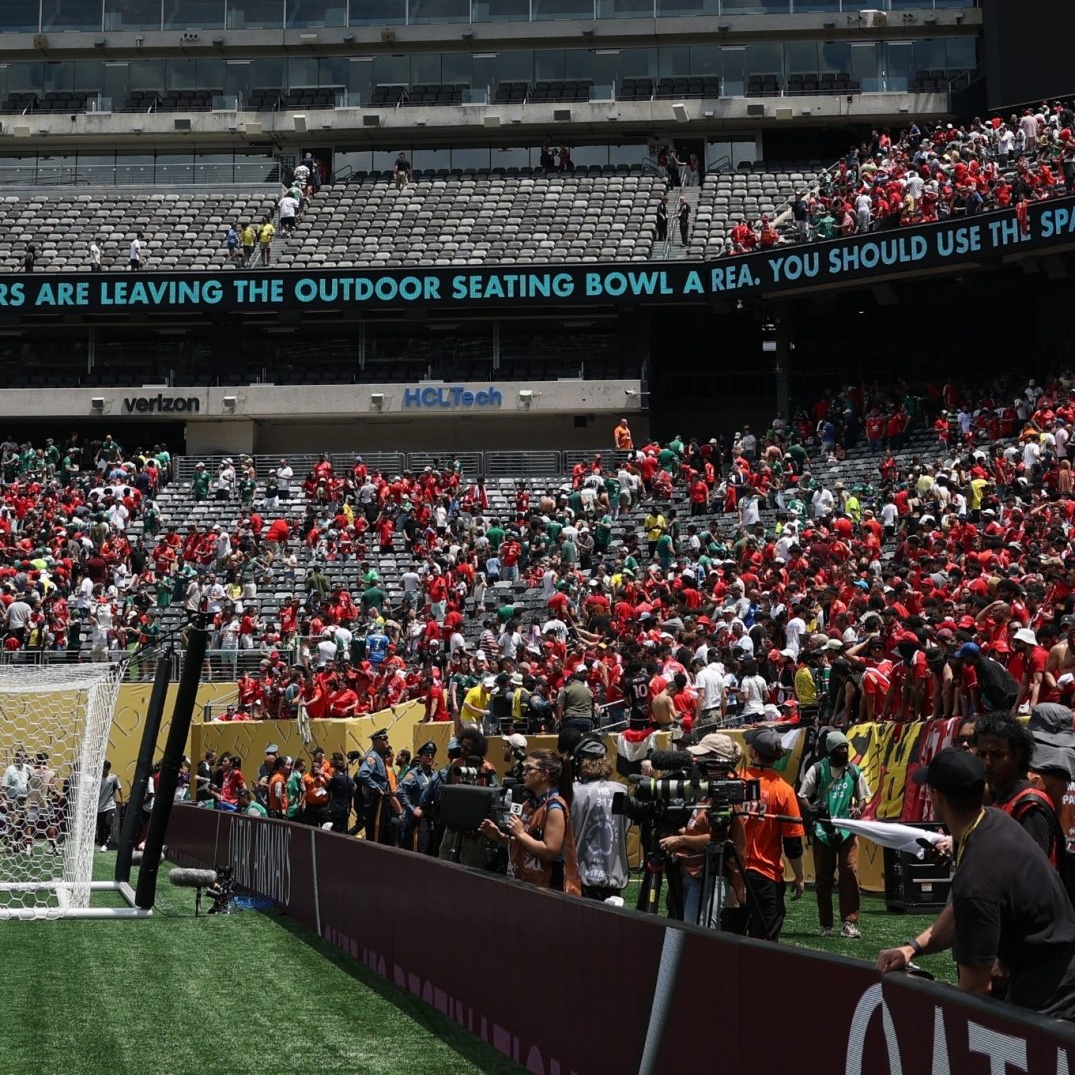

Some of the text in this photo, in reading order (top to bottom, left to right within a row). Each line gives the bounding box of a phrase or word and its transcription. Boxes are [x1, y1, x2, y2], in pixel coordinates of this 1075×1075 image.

[35, 282, 89, 305] ARE
[100, 279, 224, 305] LEAVING
[233, 279, 284, 303] THE
[295, 275, 442, 302] OUTDOOR
[451, 272, 575, 300] SEATING
[586, 271, 674, 297] BOWL
[768, 252, 820, 282] YOU
[828, 235, 928, 274] SHOULD
[936, 225, 981, 257] USE
[123, 393, 200, 412] verizon
[404, 386, 503, 407] HCLTech
[374, 637, 381, 651] 7
[632, 683, 648, 699] 10
[595, 797, 613, 808] 317
